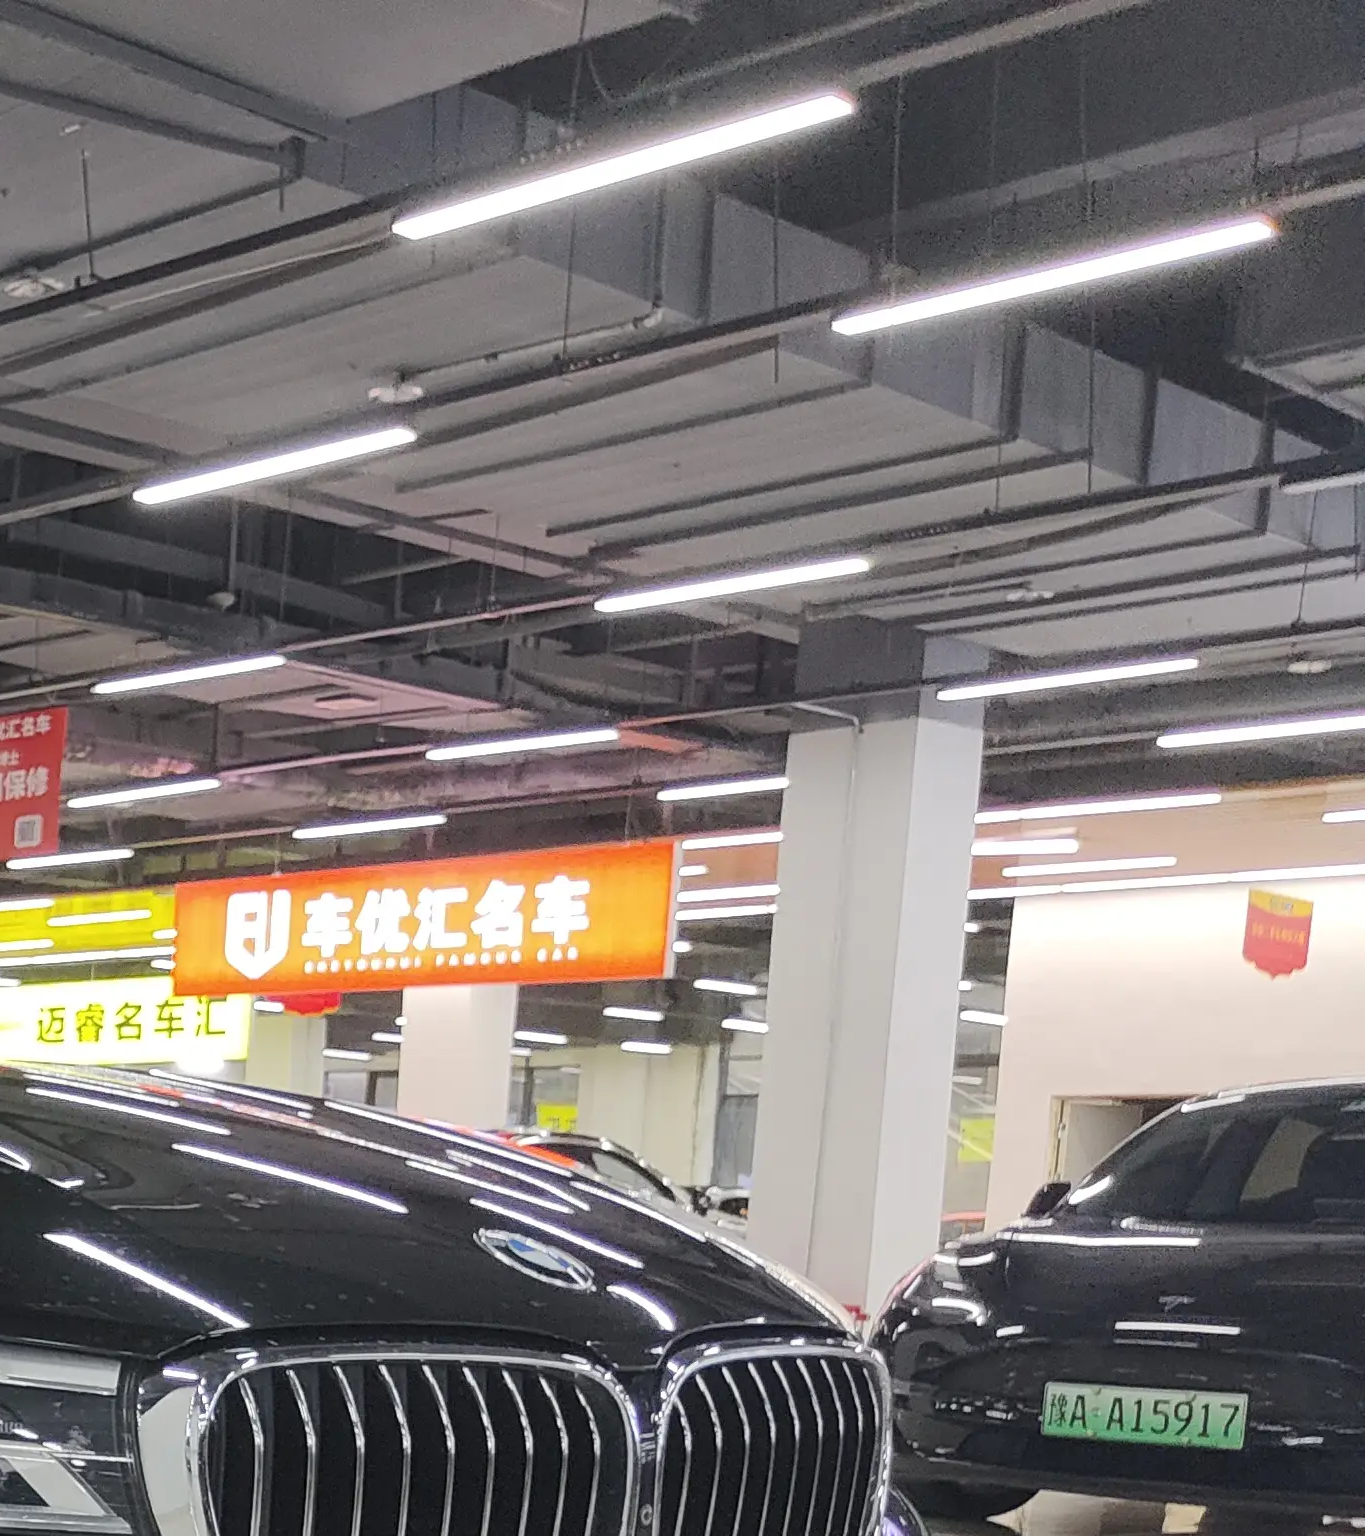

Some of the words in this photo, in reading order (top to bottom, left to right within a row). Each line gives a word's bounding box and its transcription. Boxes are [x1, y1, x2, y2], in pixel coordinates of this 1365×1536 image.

[301, 874, 591, 958] 车优汇名车
[36, 996, 227, 1043] 迈睿名车汇
